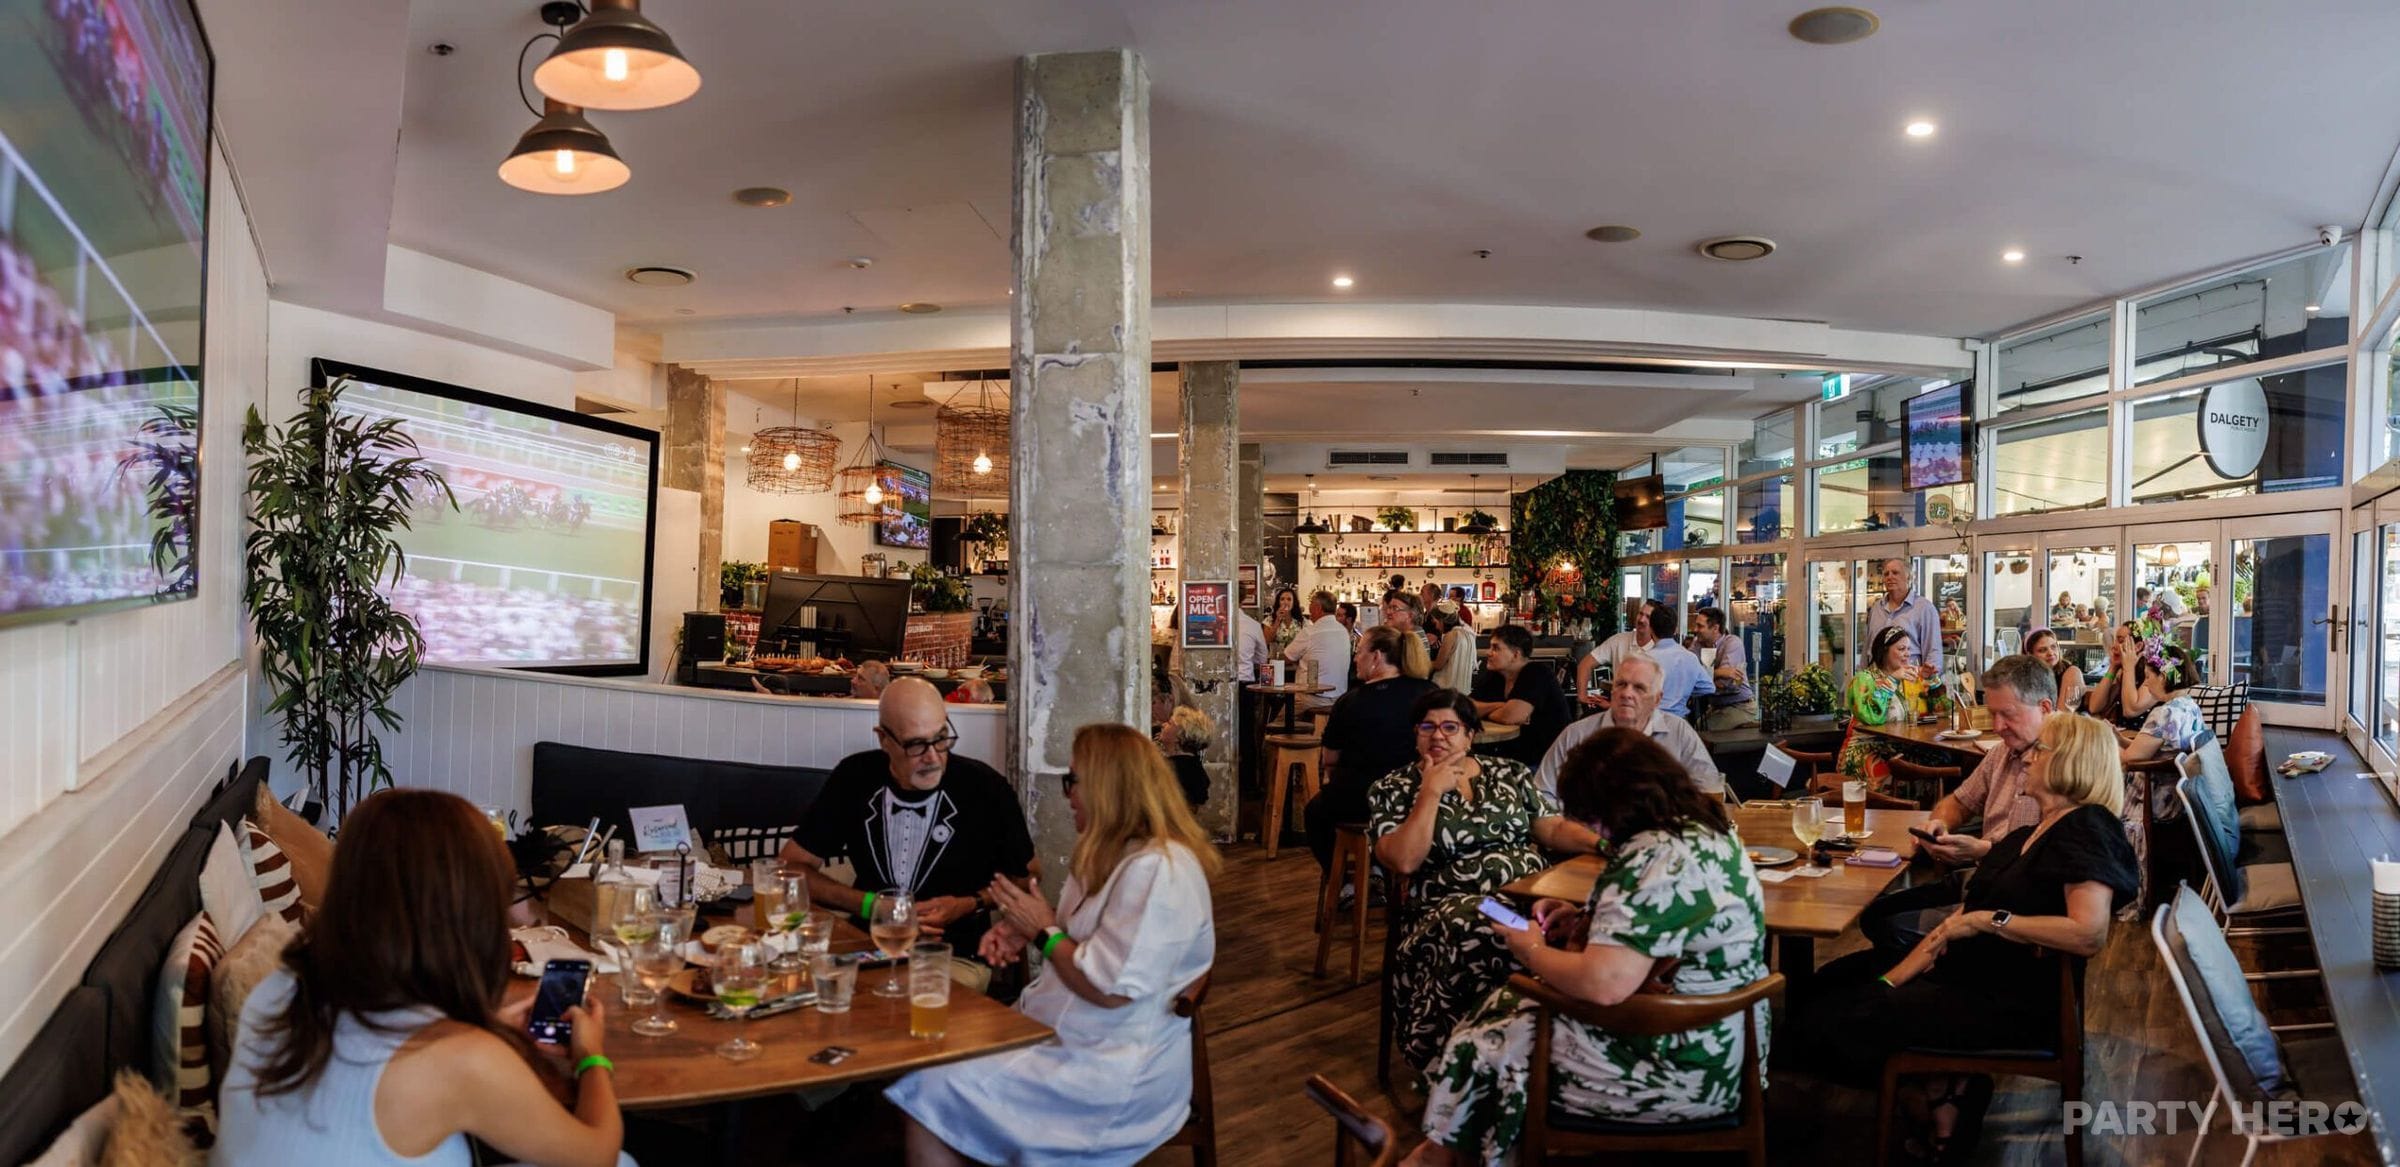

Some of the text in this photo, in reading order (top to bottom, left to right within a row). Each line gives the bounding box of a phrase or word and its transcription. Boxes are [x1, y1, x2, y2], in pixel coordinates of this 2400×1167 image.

[2210, 412, 2259, 428] DALGETY
[1188, 595, 1214, 604] OPEN
[1189, 603, 1215, 615] MIC
